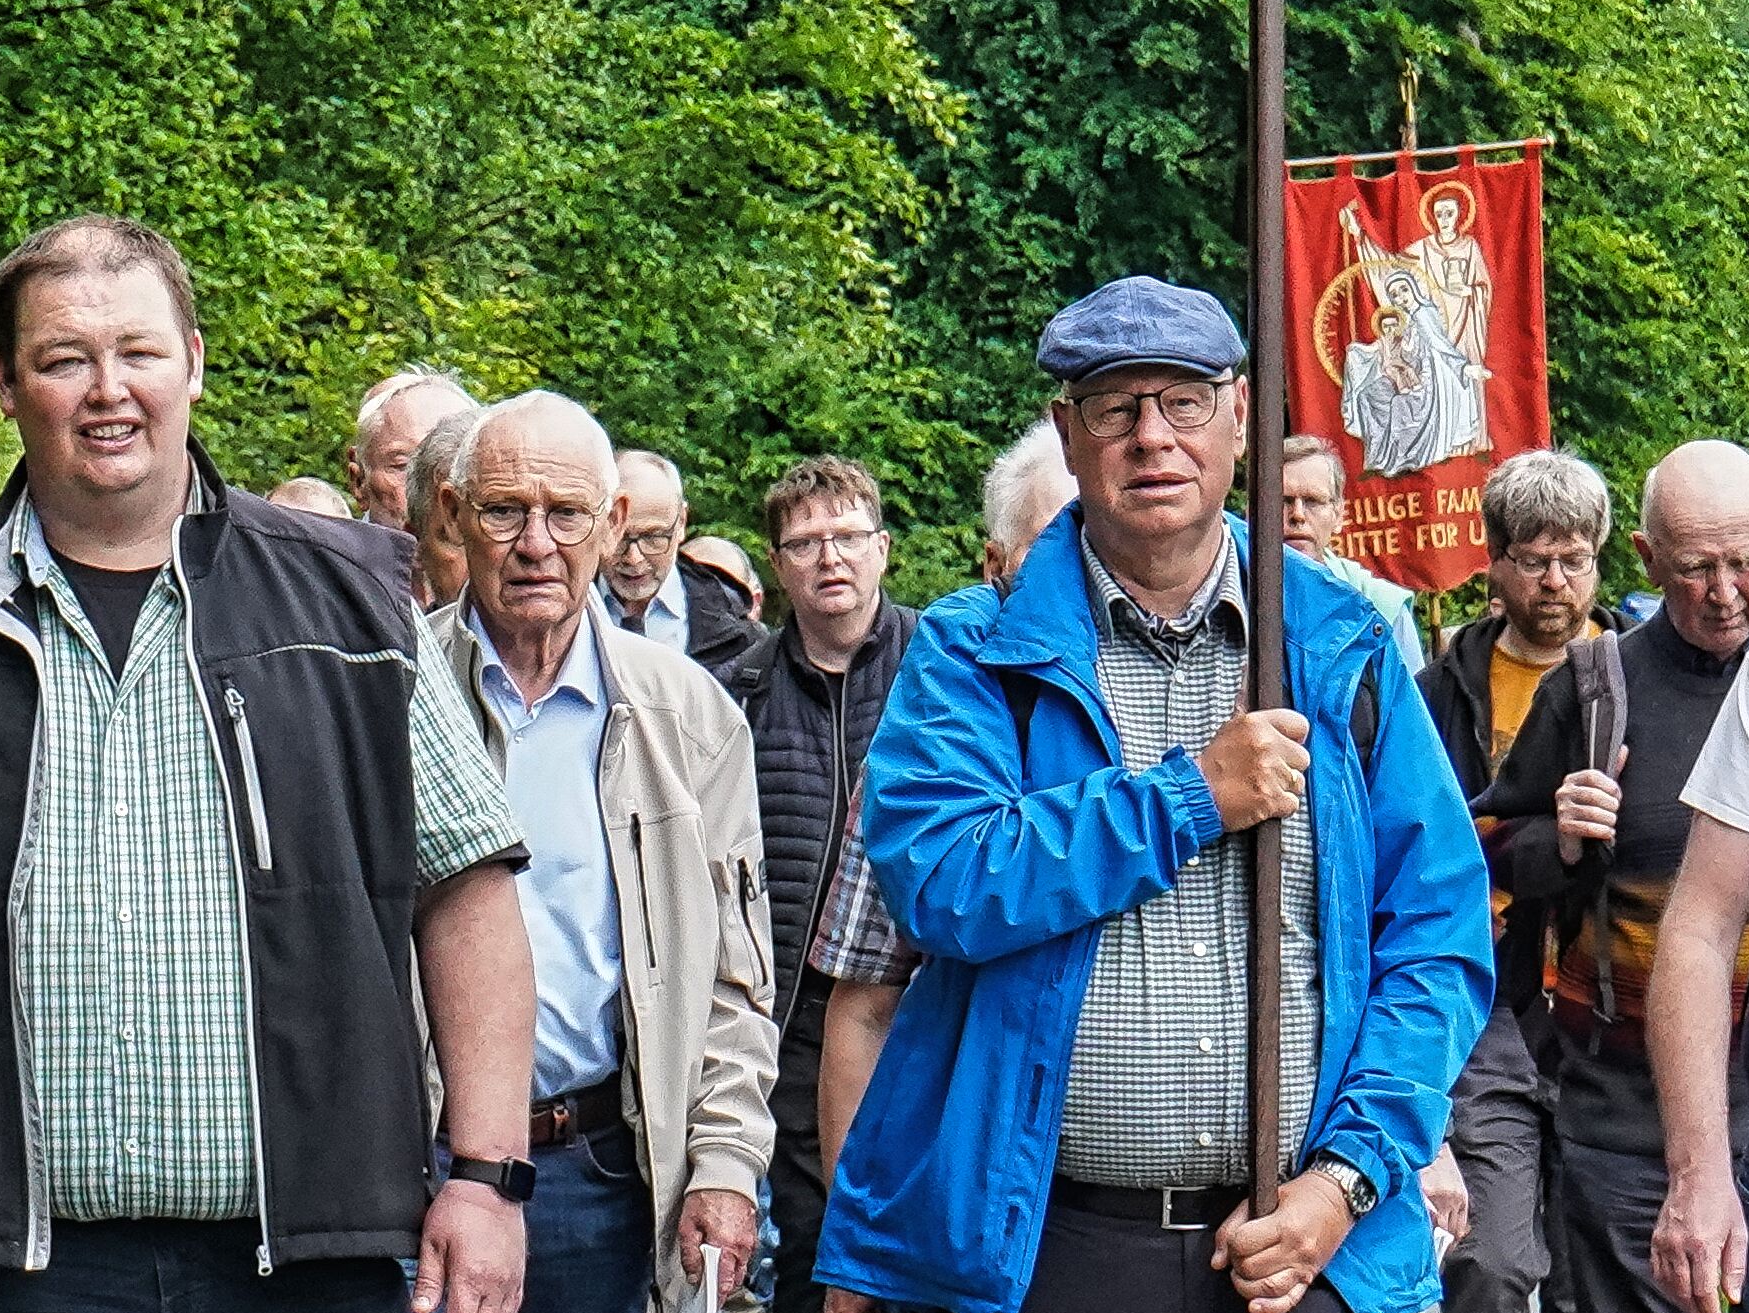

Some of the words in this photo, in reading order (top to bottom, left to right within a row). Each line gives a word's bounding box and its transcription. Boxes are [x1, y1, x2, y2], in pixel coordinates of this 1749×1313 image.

[1342, 491, 1423, 526] EILIGE
[1436, 487, 1482, 514] FAM
[1469, 519, 1487, 546] U
